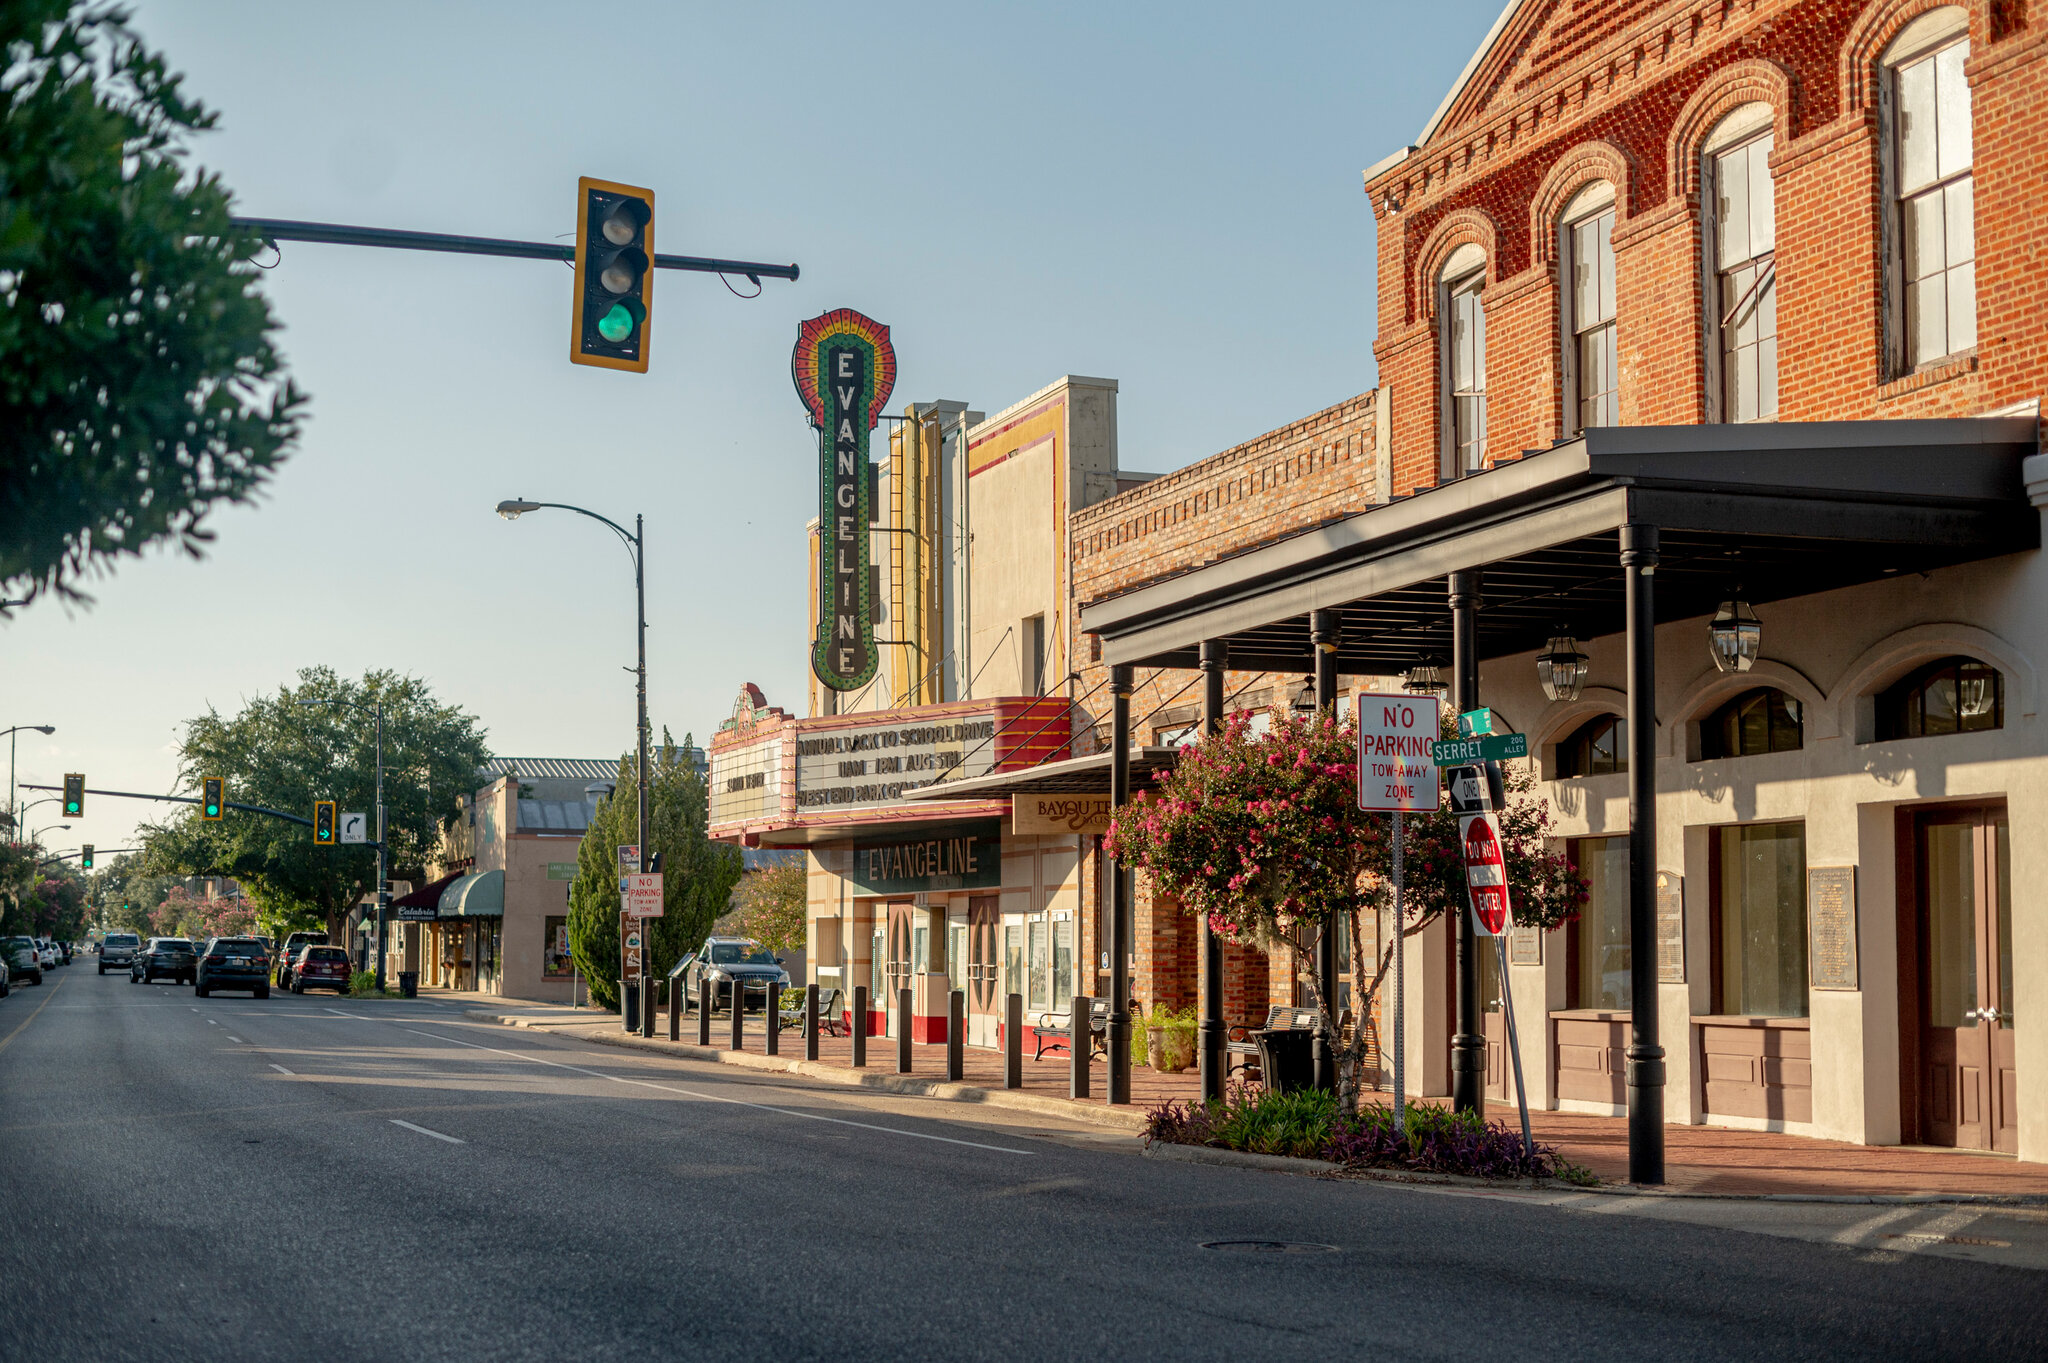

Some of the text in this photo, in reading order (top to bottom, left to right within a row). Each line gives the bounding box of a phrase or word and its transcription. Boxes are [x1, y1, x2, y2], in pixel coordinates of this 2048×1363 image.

[837, 353, 855, 673] EVANGELINE
[1383, 706, 1415, 729] NO
[796, 738, 841, 757] ANNUAL
[879, 731, 898, 748] TO
[899, 726, 951, 746] SCHOOL
[953, 721, 995, 744] DRIVE
[1364, 734, 1435, 757] PARKING
[1511, 736, 1523, 744] 200
[1435, 741, 1482, 760] SERRET
[1504, 745, 1524, 753] ALLEY
[905, 753, 932, 772] AUG
[1371, 764, 1428, 778] TOW-AWAY
[795, 788, 829, 807] WEST
[829, 786, 854, 804] END
[855, 783, 887, 802] PARK
[1385, 785, 1415, 798] ZONE
[1463, 780, 1478, 798] ONE
[1038, 801, 1090, 815] BAYOU
[869, 836, 977, 880] EVANGELINE
[1468, 840, 1496, 858] DO NOT
[639, 878, 653, 886] NO
[630, 889, 661, 897] PARKING
[1478, 892, 1502, 911] ENTER
[398, 906, 436, 916] Calabria
